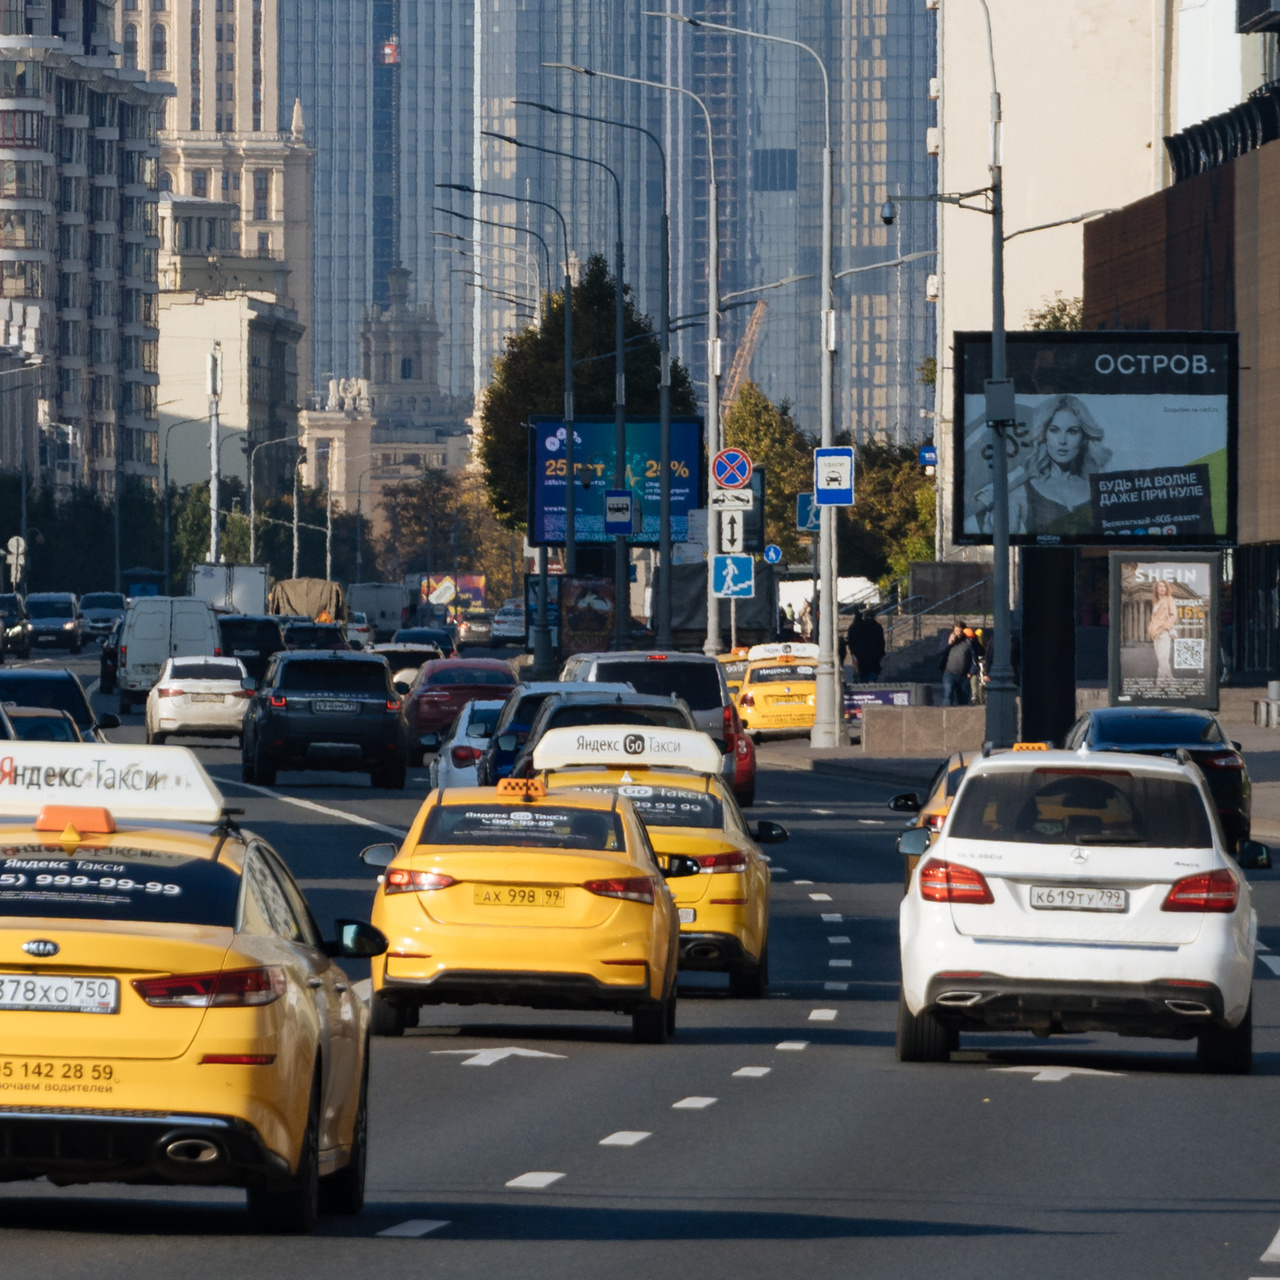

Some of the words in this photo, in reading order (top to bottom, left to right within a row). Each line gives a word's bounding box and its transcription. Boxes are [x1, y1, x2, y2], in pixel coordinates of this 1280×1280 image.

[1095, 354, 1216, 375] ОСТРОВ.
[1099, 479, 1132, 492] БУДЬ
[1135, 477, 1152, 488] НА
[1154, 472, 1198, 487] ВОЛНЕ
[1100, 491, 1139, 507] ДАЖЕ
[1141, 488, 1167, 501] ПРИ
[1169, 485, 1204, 498] НУЛЕ
[1135, 568, 1197, 582] SHEIN
[1178, 606, 1204, 619] 15%
[576, 735, 620, 752] Яндекс
[625, 735, 643, 753] Go
[648, 737, 681, 753] Такси
[92, 760, 159, 791] Такси
[660, 788, 709, 800] Такси
[680, 802, 701, 811] 99
[534, 813, 568, 821] Такси
[4, 858, 69, 871] Яндекс
[75, 860, 124, 873] Такси
[35, 875, 182, 895] 999-99-99
[508, 889, 536, 903] 998
[545, 890, 560, 901] 99
[1036, 893, 1094, 905] К619ТУ
[1099, 890, 1120, 902] 799
[29, 941, 54, 954] KIA
[74, 981, 108, 999] 750
[21, 1062, 55, 1078] 142
[61, 1063, 84, 1079] 28
[91, 1064, 114, 1080] 59
[44, 1083, 113, 1093] водителей
